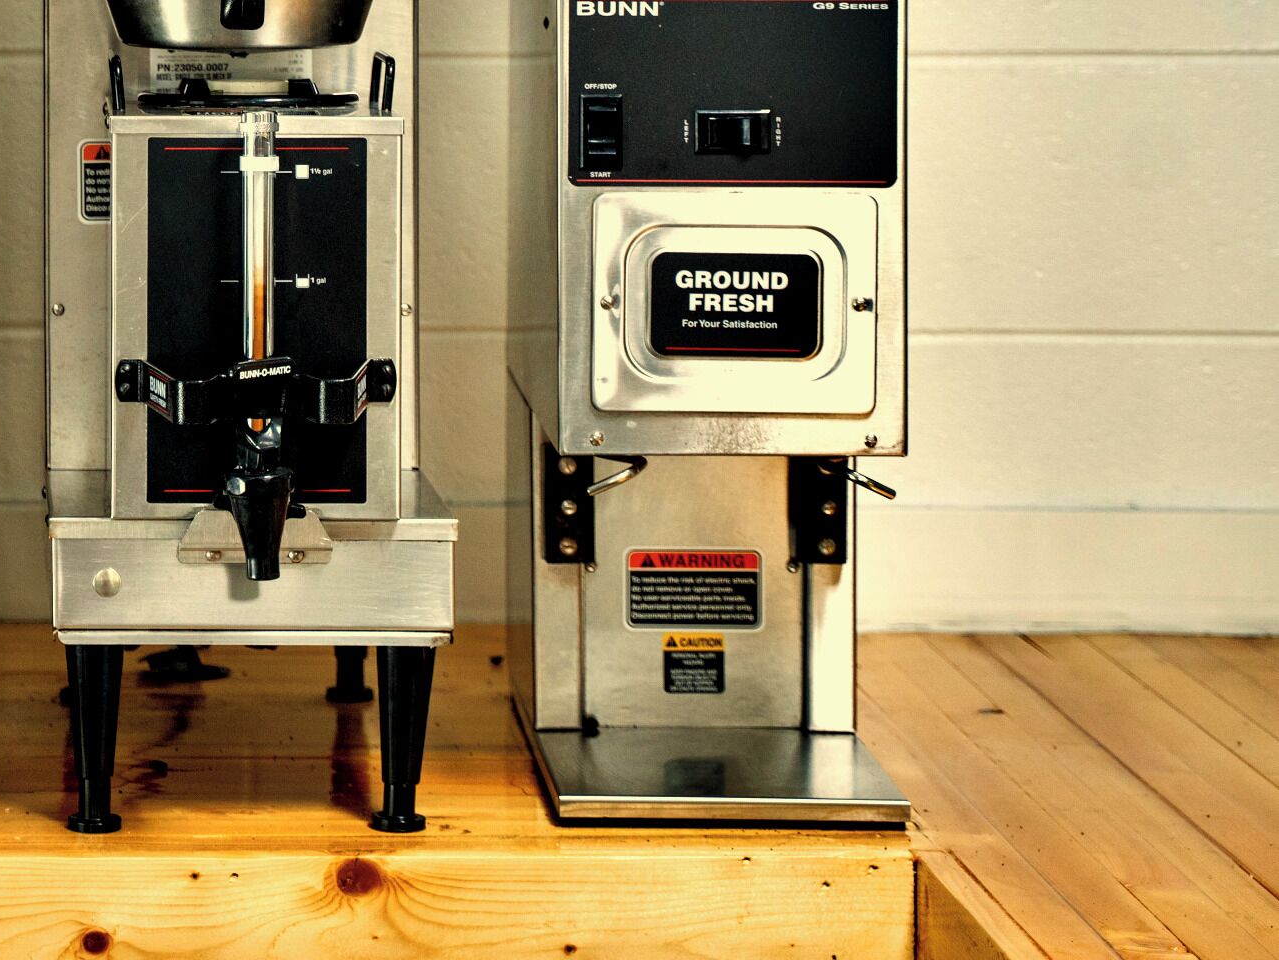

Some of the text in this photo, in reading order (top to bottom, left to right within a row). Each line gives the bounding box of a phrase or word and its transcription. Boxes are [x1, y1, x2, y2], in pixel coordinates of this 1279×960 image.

[576, 1, 659, 16] BUNN
[812, 2, 835, 10] G9
[316, 277, 326, 286] gal
[675, 270, 789, 290] GROUND
[688, 294, 774, 313] FRESH
[682, 319, 778, 329] For Your Satisfaction
[239, 365, 292, 380] BUNN-O-MATIC
[150, 376, 166, 399] BUNN
[658, 554, 745, 567] WARNING
[679, 637, 722, 647] CAUTION
